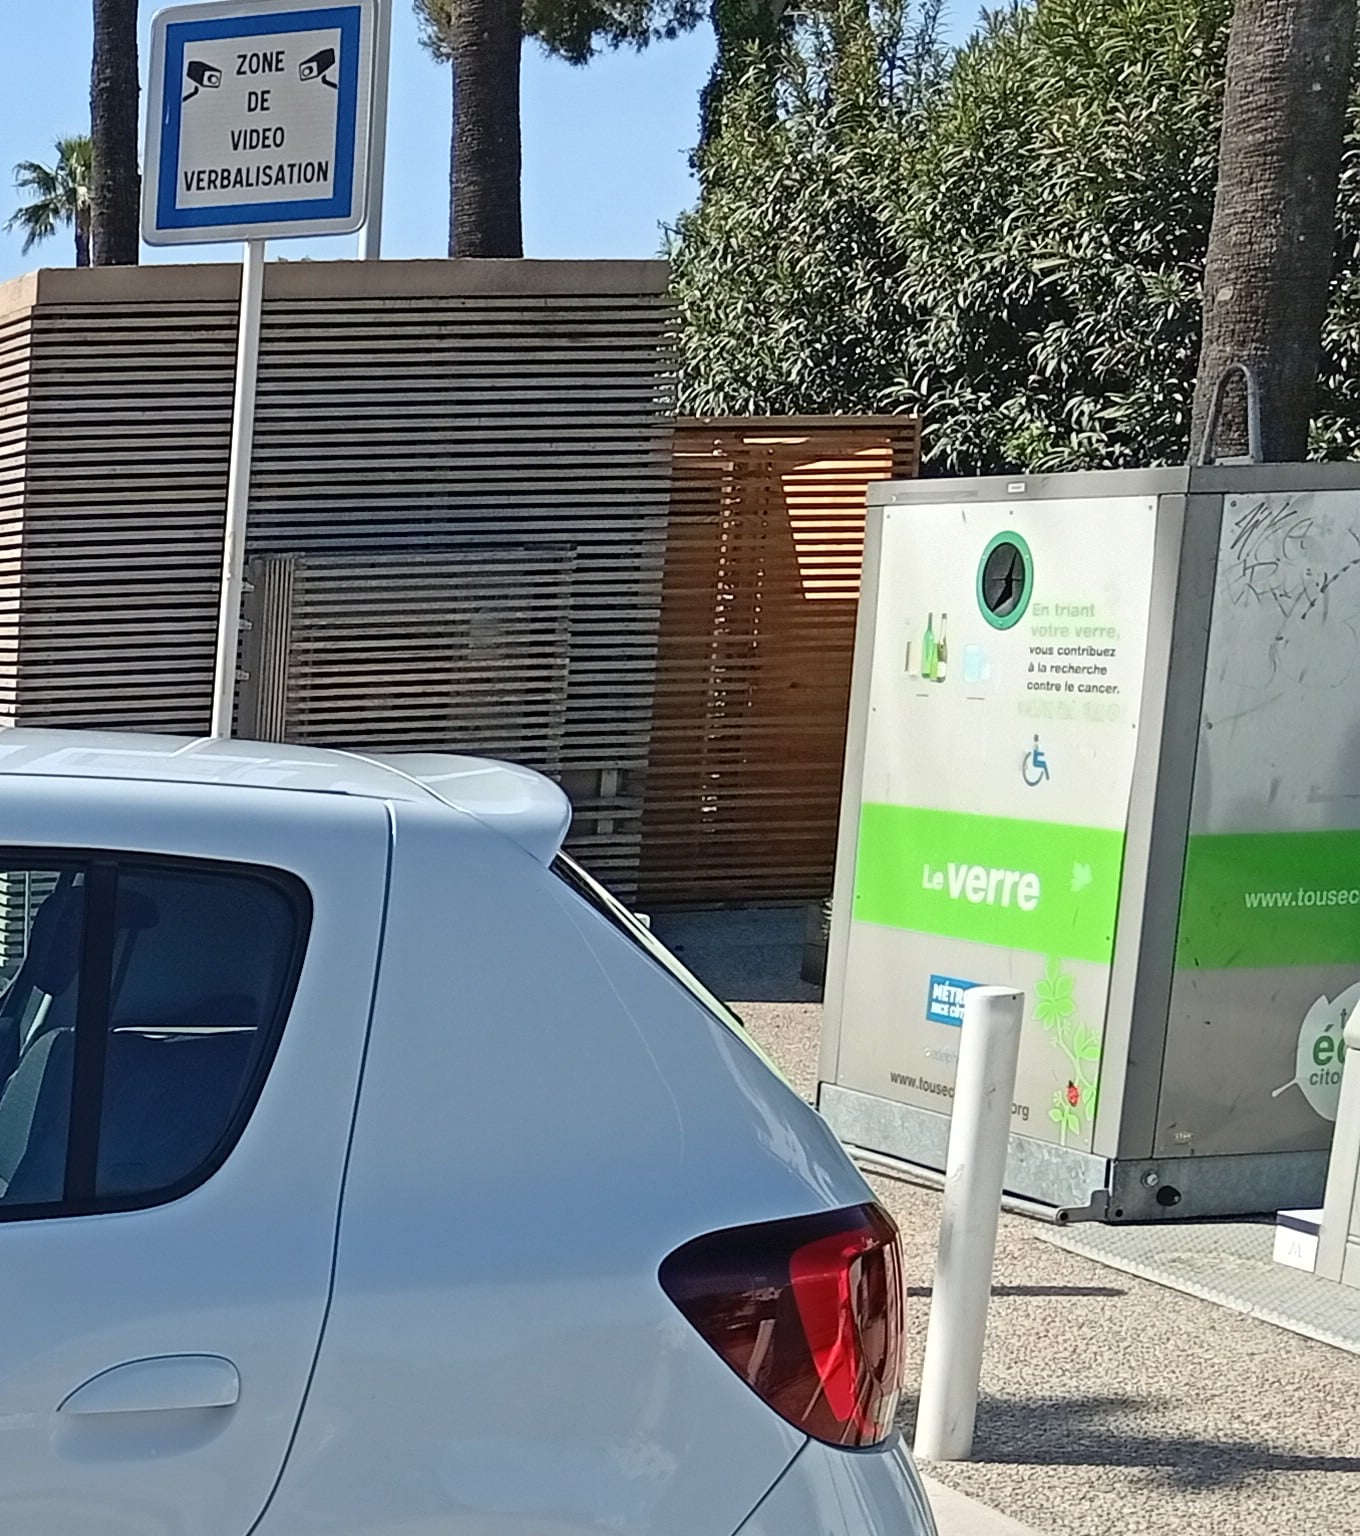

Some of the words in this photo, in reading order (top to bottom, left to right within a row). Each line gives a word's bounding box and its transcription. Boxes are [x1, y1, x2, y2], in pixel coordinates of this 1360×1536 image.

[236, 51, 285, 76] ZONE
[247, 90, 271, 113] DE
[231, 127, 285, 151] VIDEO
[184, 161, 329, 192] VERBALISATION
[1032, 603, 1049, 617] En
[1055, 603, 1095, 617] triant
[1031, 624, 1069, 638] votre
[1075, 625, 1120, 640] verre,
[1029, 646, 1054, 656] vous
[1057, 645, 1116, 657] contribuez
[1028, 662, 1034, 673] à
[1038, 662, 1047, 673] la
[1050, 663, 1108, 676] recherche
[1027, 681, 1061, 692] contre
[1065, 681, 1074, 692] le
[1077, 683, 1120, 694] cancer.
[922, 863, 944, 890] Le
[947, 862, 1040, 912] verre
[1245, 887, 1360, 908] www.tousec
